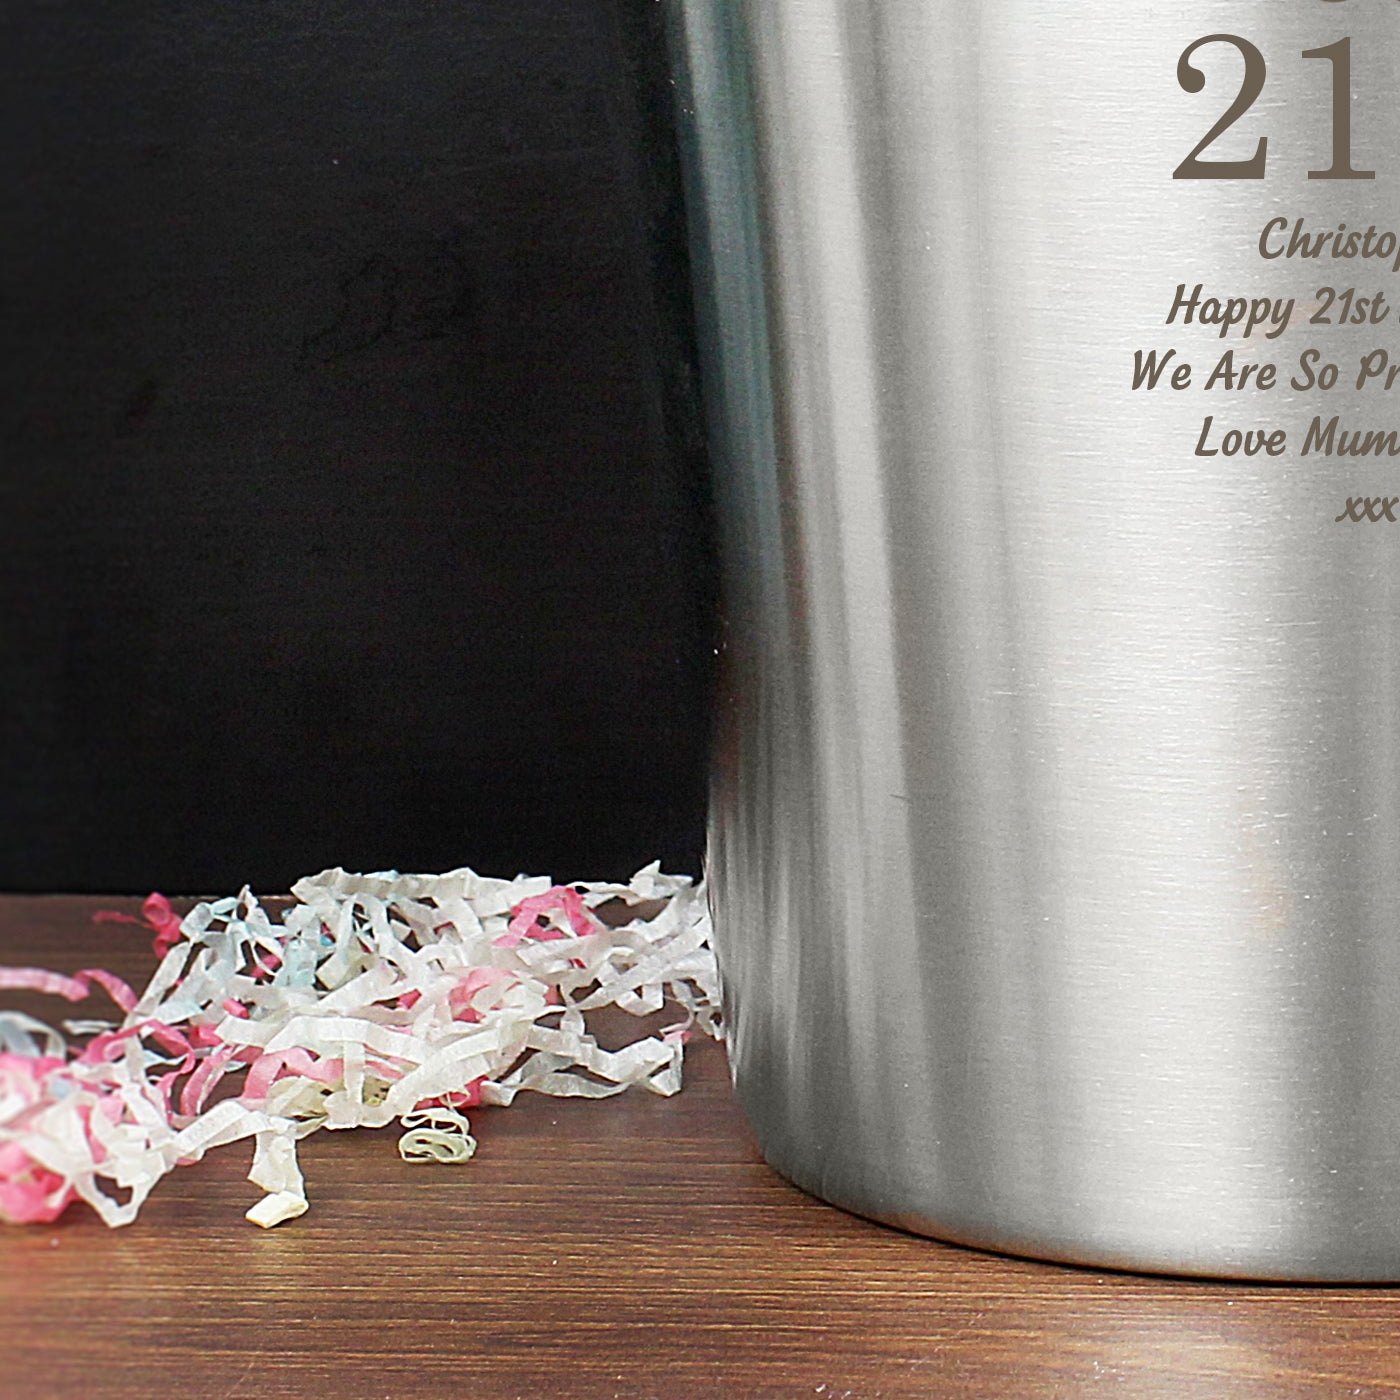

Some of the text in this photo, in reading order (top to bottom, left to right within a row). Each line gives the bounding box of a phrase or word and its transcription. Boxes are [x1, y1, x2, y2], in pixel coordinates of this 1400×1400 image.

[1165, 283, 1295, 340] Happy
[1309, 285, 1391, 325] 21st
[1131, 348, 1192, 391] We
[1204, 349, 1277, 391] Are
[1290, 348, 1339, 392] So
[1194, 415, 1287, 457] Love
[1334, 496, 1400, 523] xxx
